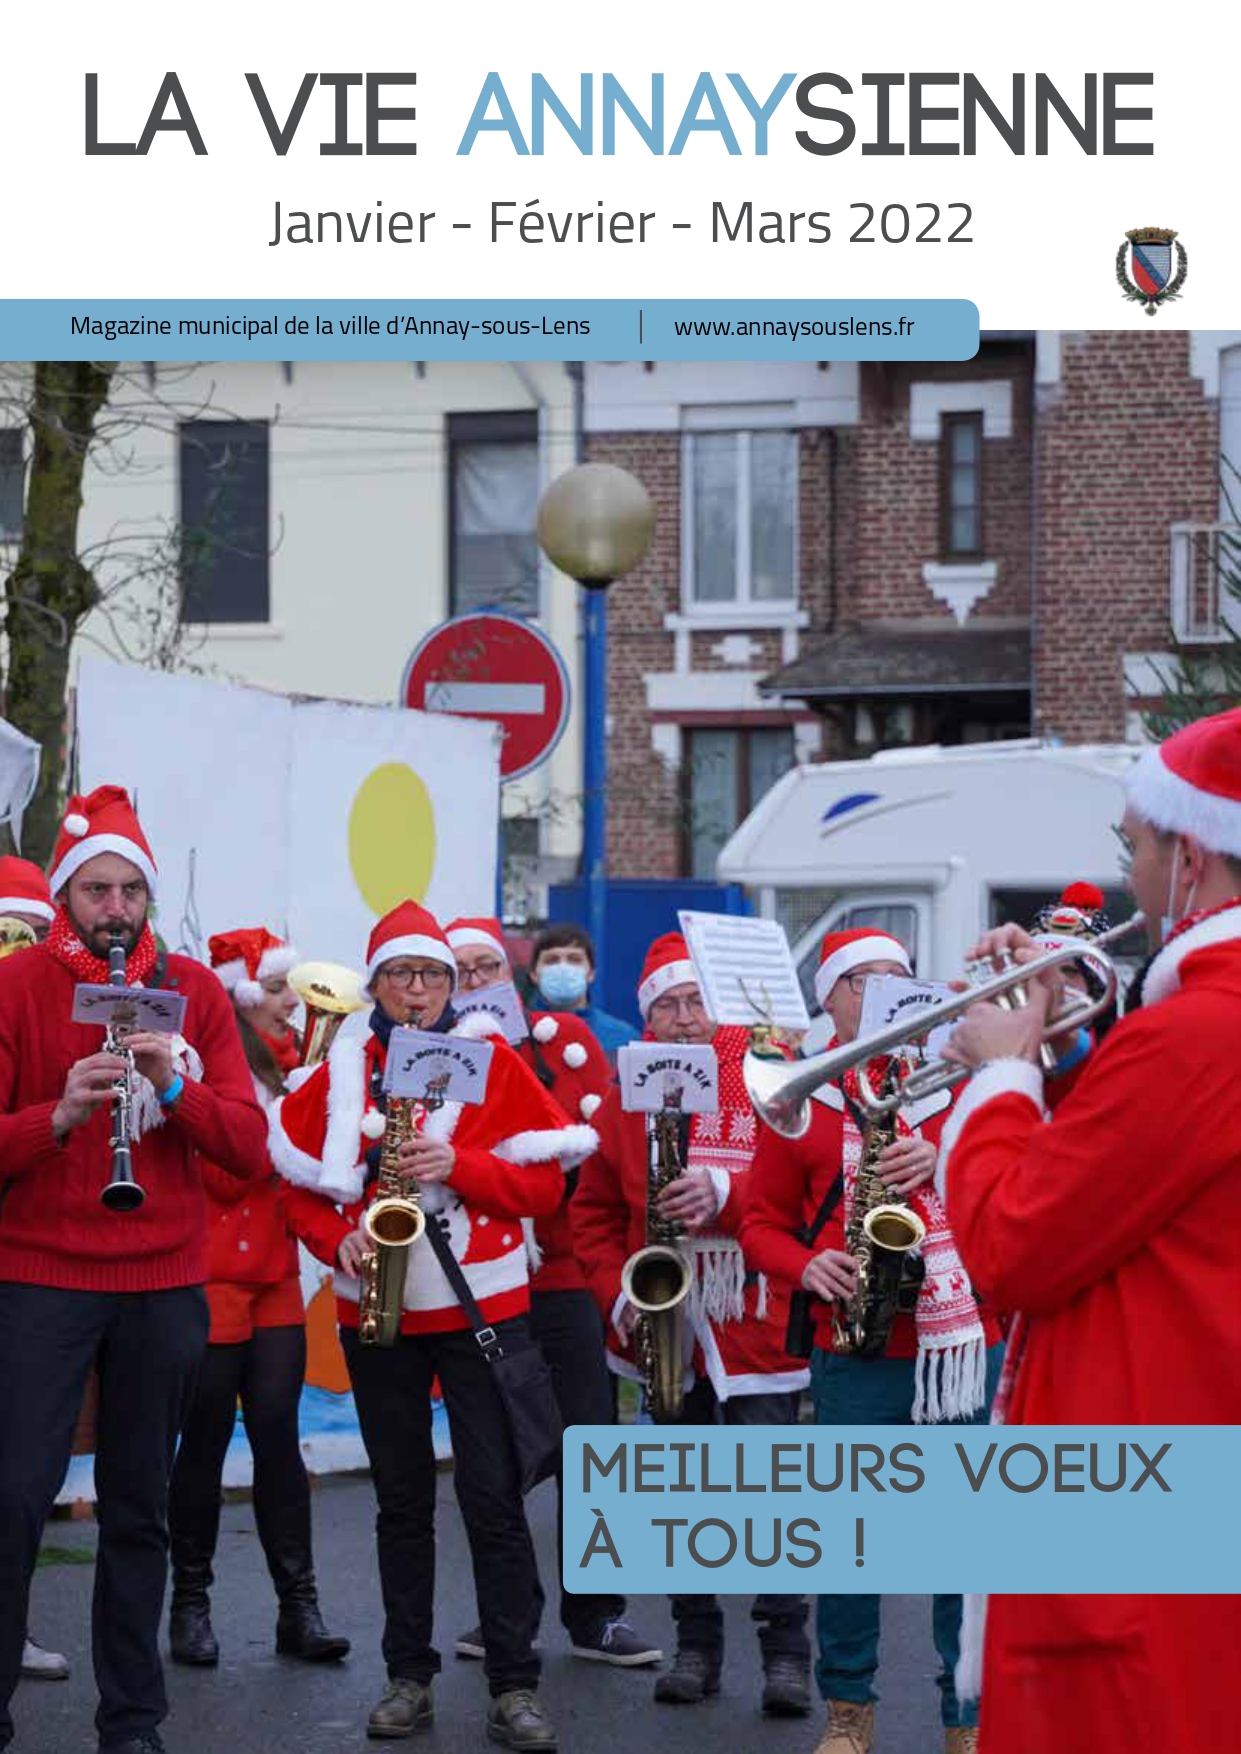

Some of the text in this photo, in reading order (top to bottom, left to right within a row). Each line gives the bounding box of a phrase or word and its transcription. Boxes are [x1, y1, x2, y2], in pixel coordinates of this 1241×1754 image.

[452, 1051, 462, 1061] A
[634, 1059, 712, 1090] LA BOITE A ZIK
